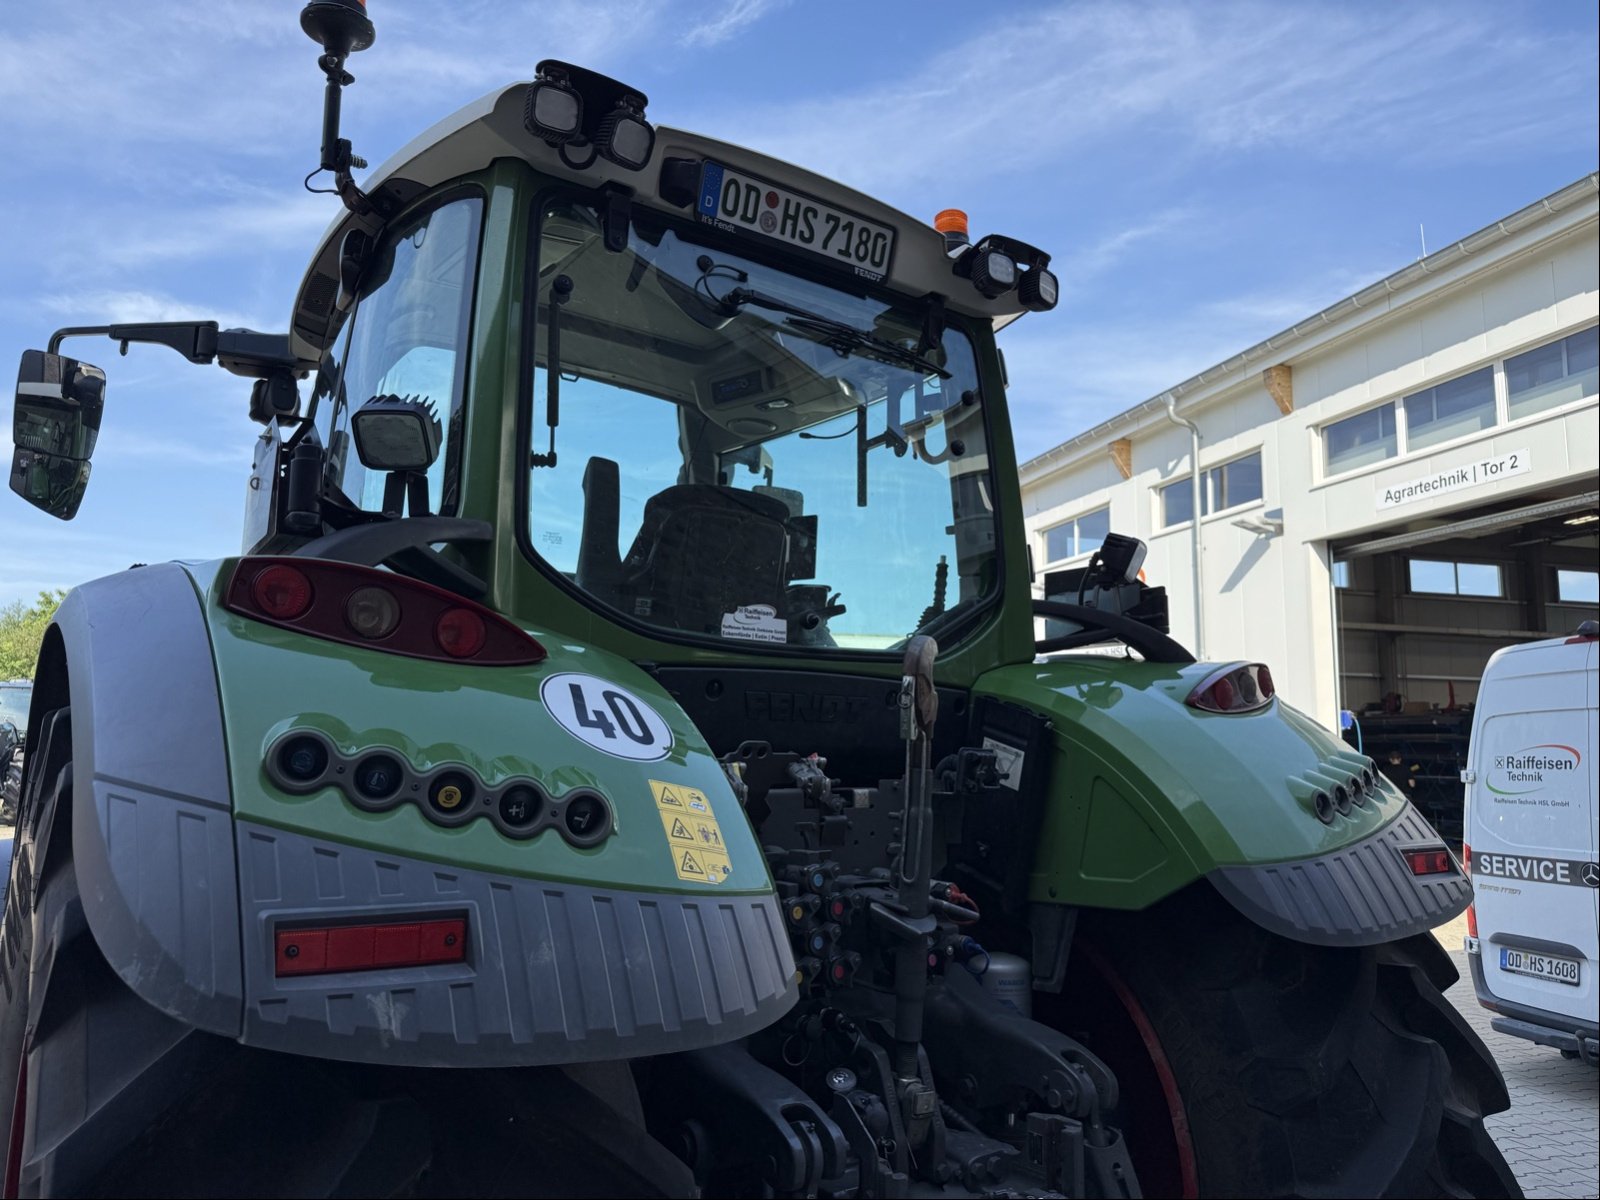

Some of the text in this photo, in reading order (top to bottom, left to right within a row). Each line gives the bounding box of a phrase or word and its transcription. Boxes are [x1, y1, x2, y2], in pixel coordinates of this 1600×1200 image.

[705, 178, 888, 268] D OD HS 7180
[1384, 469, 1469, 503] Agrartechnik
[1481, 461, 1505, 476] Tor
[1509, 454, 1518, 469] 2
[568, 683, 655, 745] 40
[1506, 756, 1573, 770] Raiffeisen
[1507, 771, 1543, 782] Technik
[1480, 854, 1571, 882] SERVICE
[1508, 952, 1522, 968] OD
[1529, 956, 1544, 973] HS
[1547, 960, 1576, 979] 1608
